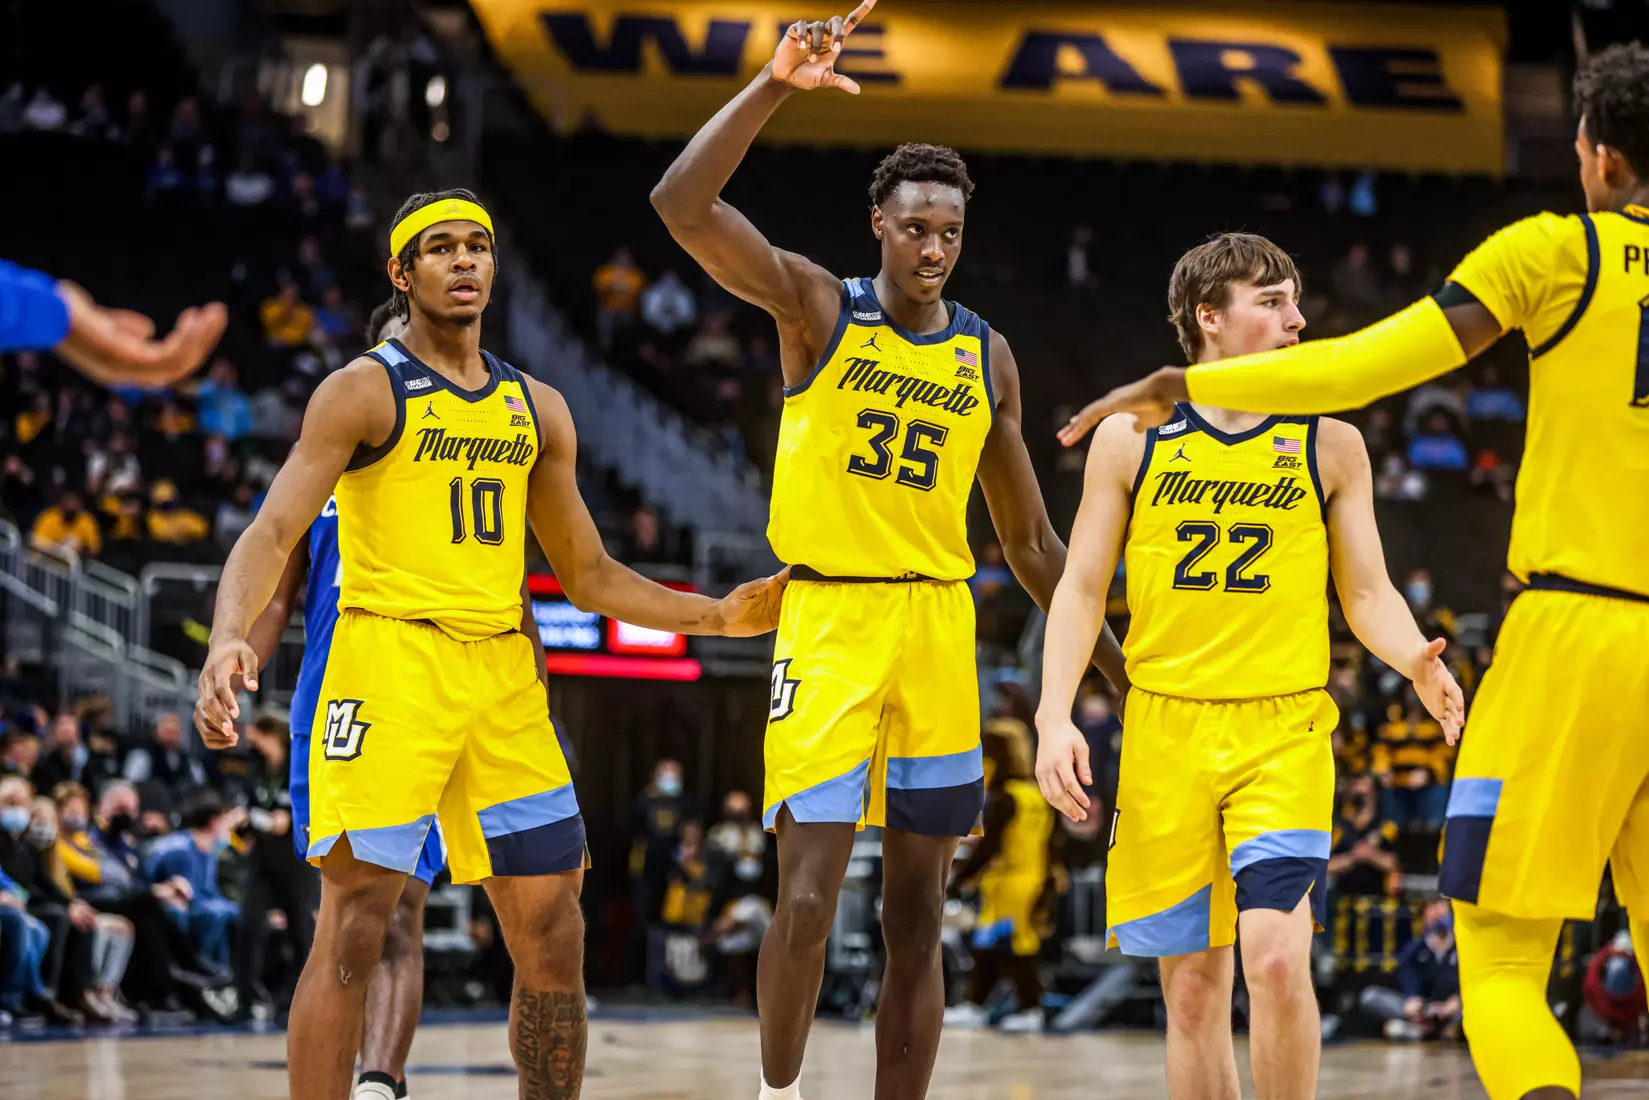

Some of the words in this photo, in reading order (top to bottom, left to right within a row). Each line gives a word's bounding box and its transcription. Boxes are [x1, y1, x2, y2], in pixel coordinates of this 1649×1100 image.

[998, 30, 1466, 113] ARE
[837, 357, 979, 416] Marquette
[955, 370, 980, 380] EAST
[958, 366, 975, 374] BIG
[413, 428, 534, 470] Marquette
[847, 408, 949, 492] 35
[1273, 461, 1303, 469] EAST
[449, 477, 506, 546] 10
[1152, 471, 1307, 514] Marquette
[1172, 520, 1274, 594] 22
[322, 699, 373, 762] MU
